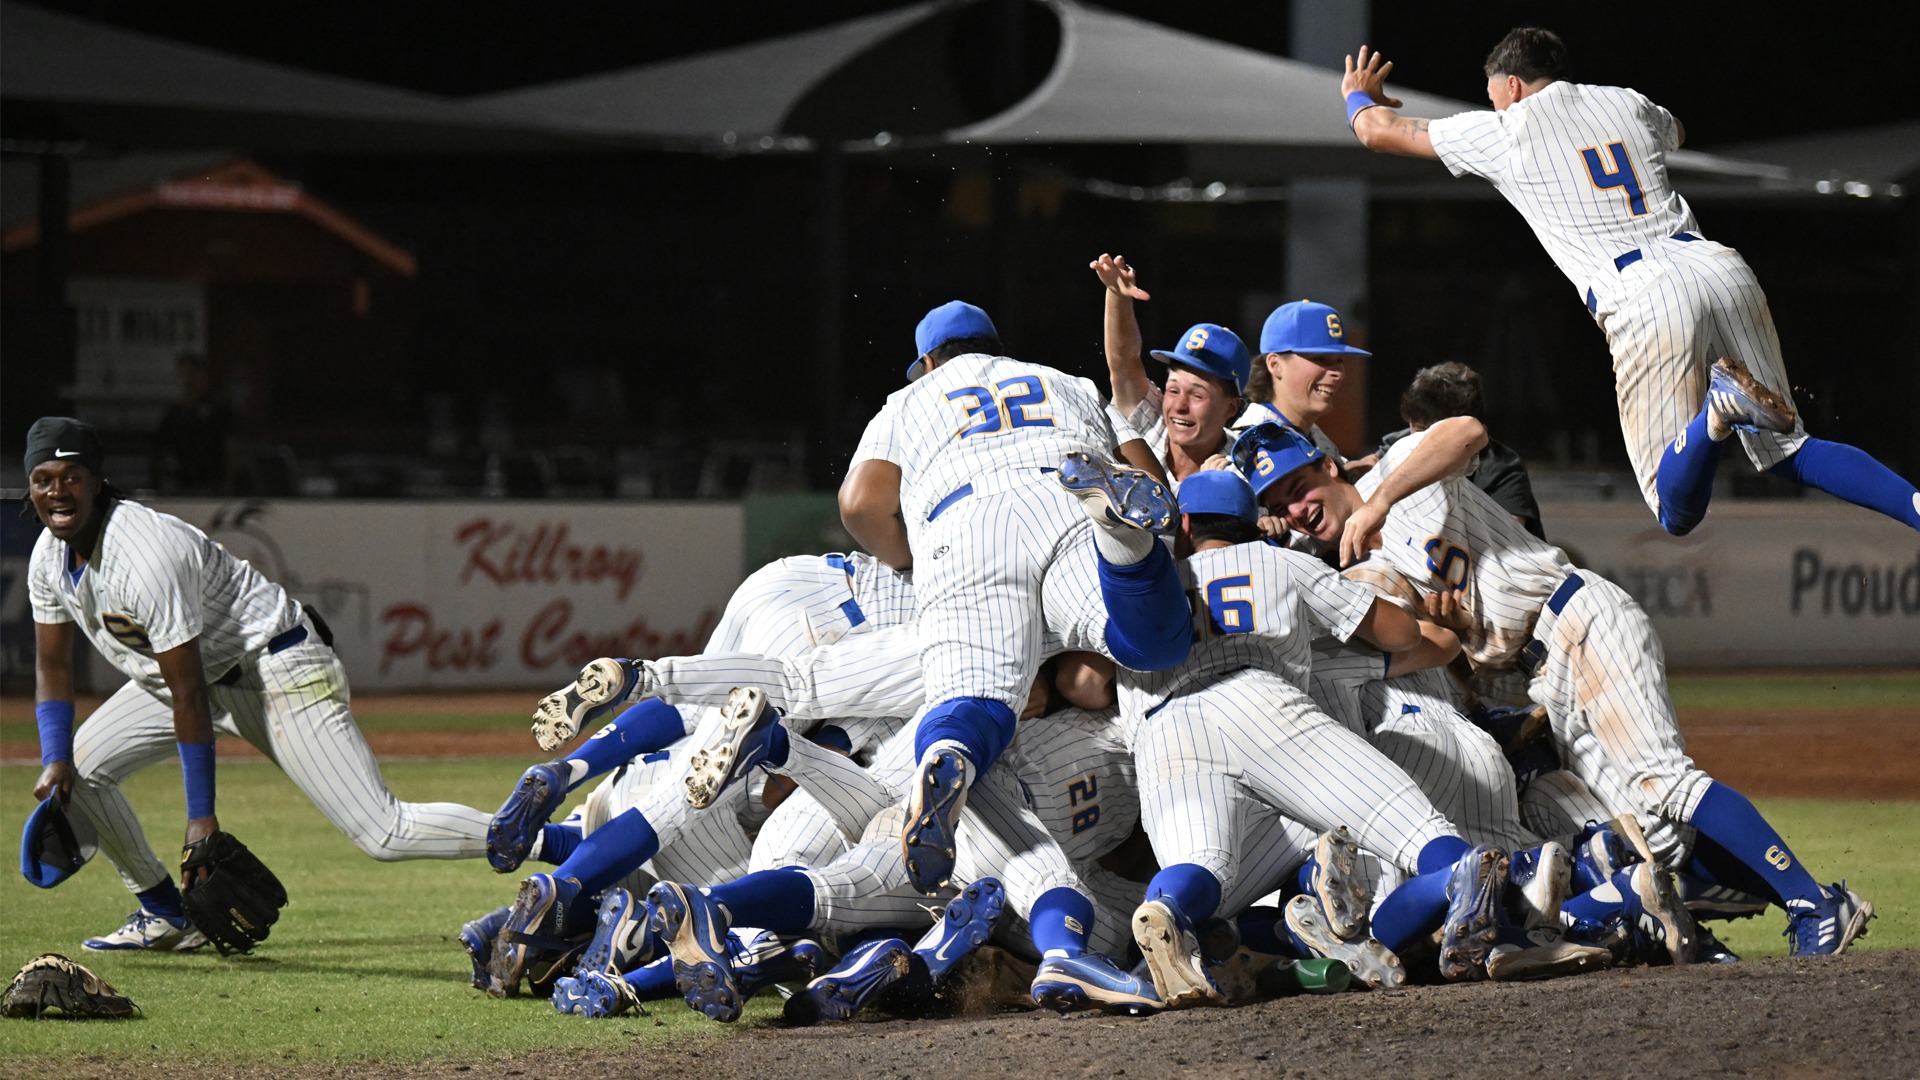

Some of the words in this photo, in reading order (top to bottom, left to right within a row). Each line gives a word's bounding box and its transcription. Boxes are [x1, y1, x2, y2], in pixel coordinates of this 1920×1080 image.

[1578, 140, 1651, 216] 4
[1185, 328, 1209, 351] S
[1327, 313, 1343, 338] S
[945, 374, 1057, 440] 32
[1253, 451, 1275, 477] S
[455, 516, 643, 600] Killroy
[376, 602, 504, 676] Pest
[1185, 573, 1258, 642] 6
[1067, 773, 1101, 836] 28
[1764, 845, 1791, 871] S
[1064, 915, 1084, 935] S
